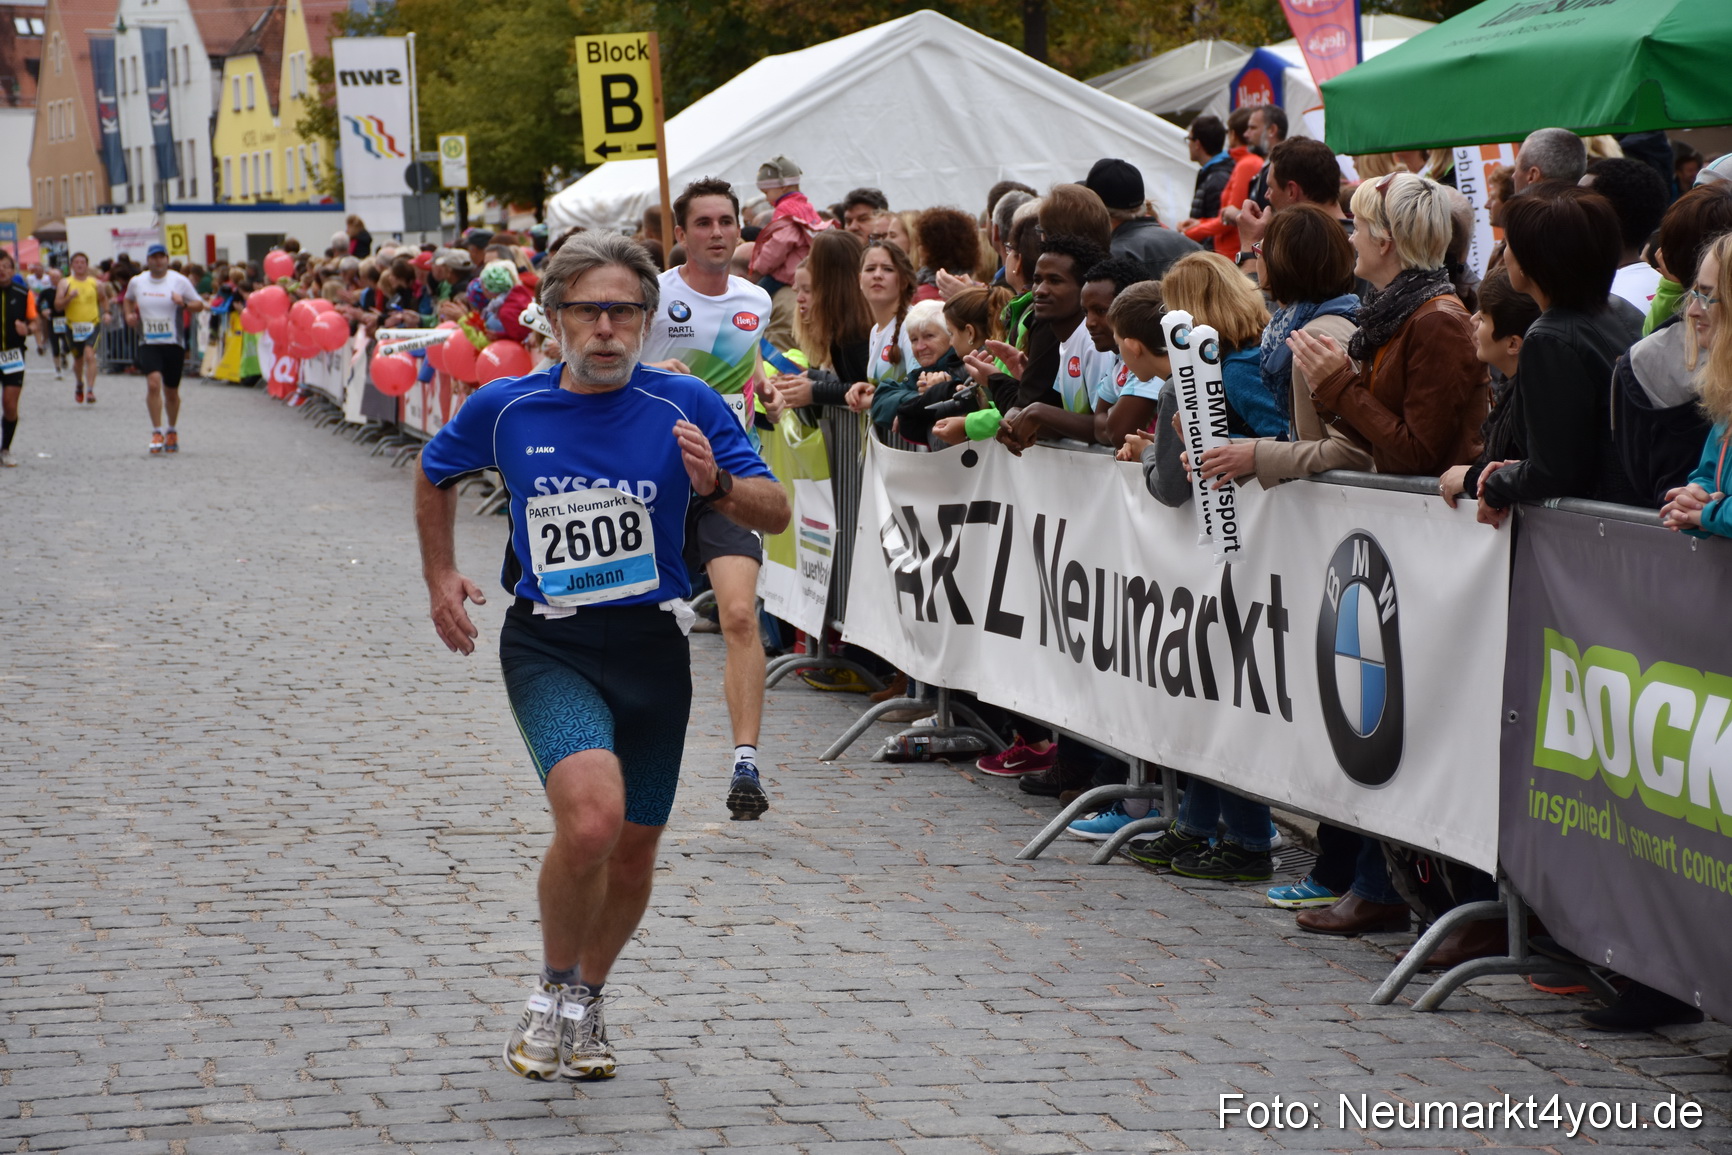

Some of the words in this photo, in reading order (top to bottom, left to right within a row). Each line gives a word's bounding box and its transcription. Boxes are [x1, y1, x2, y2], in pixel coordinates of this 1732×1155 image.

[586, 38, 651, 64] Block
[601, 73, 643, 134] B
[171, 233, 183, 250] D
[1205, 380, 1229, 439] BMW
[535, 446, 555, 454] JAKO
[529, 506, 565, 519] PARTL
[568, 496, 628, 515] Neumarkt
[541, 511, 643, 566] 2608
[566, 568, 625, 591] Johann
[1326, 539, 1397, 625] BMW
[1033, 513, 1293, 723] Neumarkt
[1528, 777, 1611, 841] inspired
[1630, 824, 1678, 875] smart
